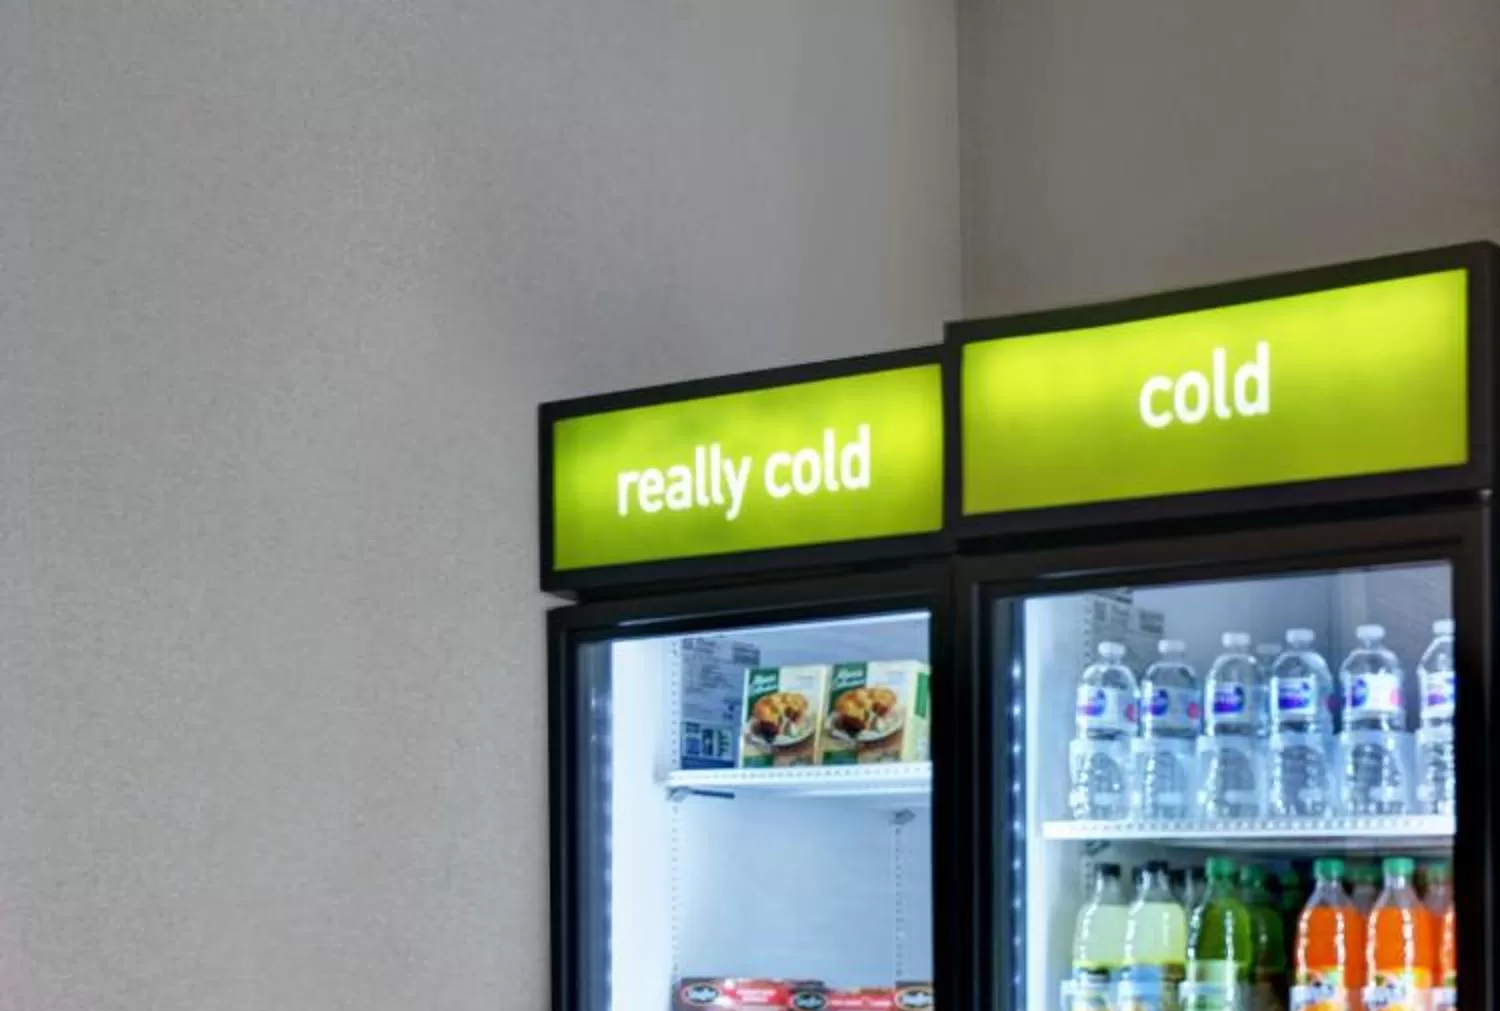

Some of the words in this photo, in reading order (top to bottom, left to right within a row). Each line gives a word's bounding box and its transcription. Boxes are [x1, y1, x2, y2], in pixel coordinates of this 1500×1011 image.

[1138, 340, 1272, 429] cold
[616, 442, 752, 521] really
[764, 423, 873, 498] cold
